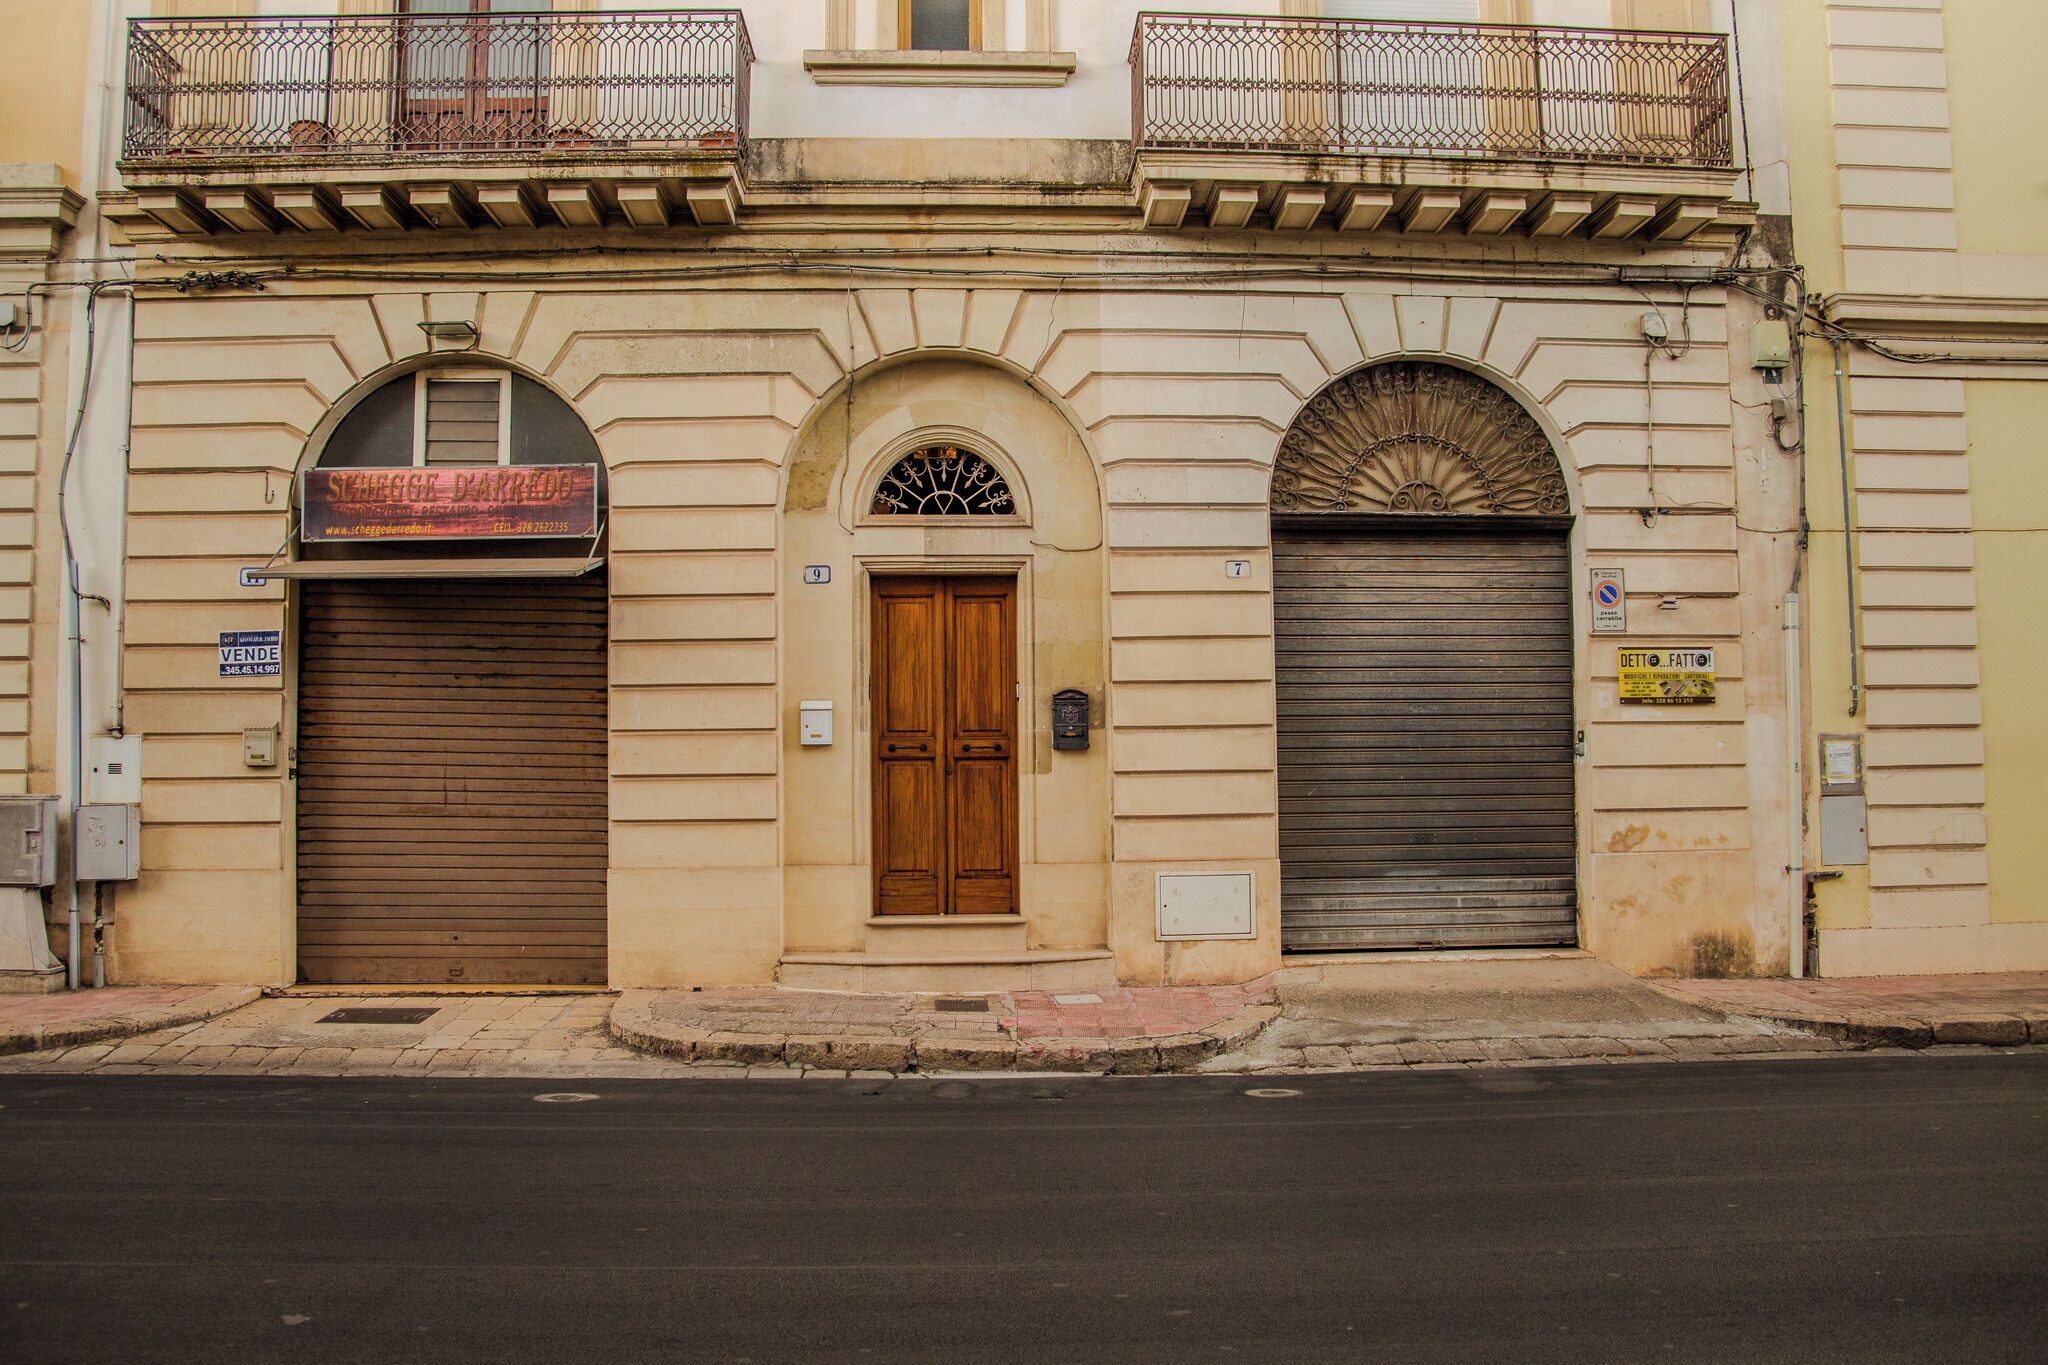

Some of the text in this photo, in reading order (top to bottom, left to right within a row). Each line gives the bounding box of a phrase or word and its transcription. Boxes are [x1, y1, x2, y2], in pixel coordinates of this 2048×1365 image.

[326, 470, 573, 502] SCHEGGE D'ARREDO
[325, 522, 433, 537] www.scheggedarredo.it
[813, 568, 821, 581] 9
[1235, 563, 1242, 575] 7
[221, 647, 279, 662] VENDE
